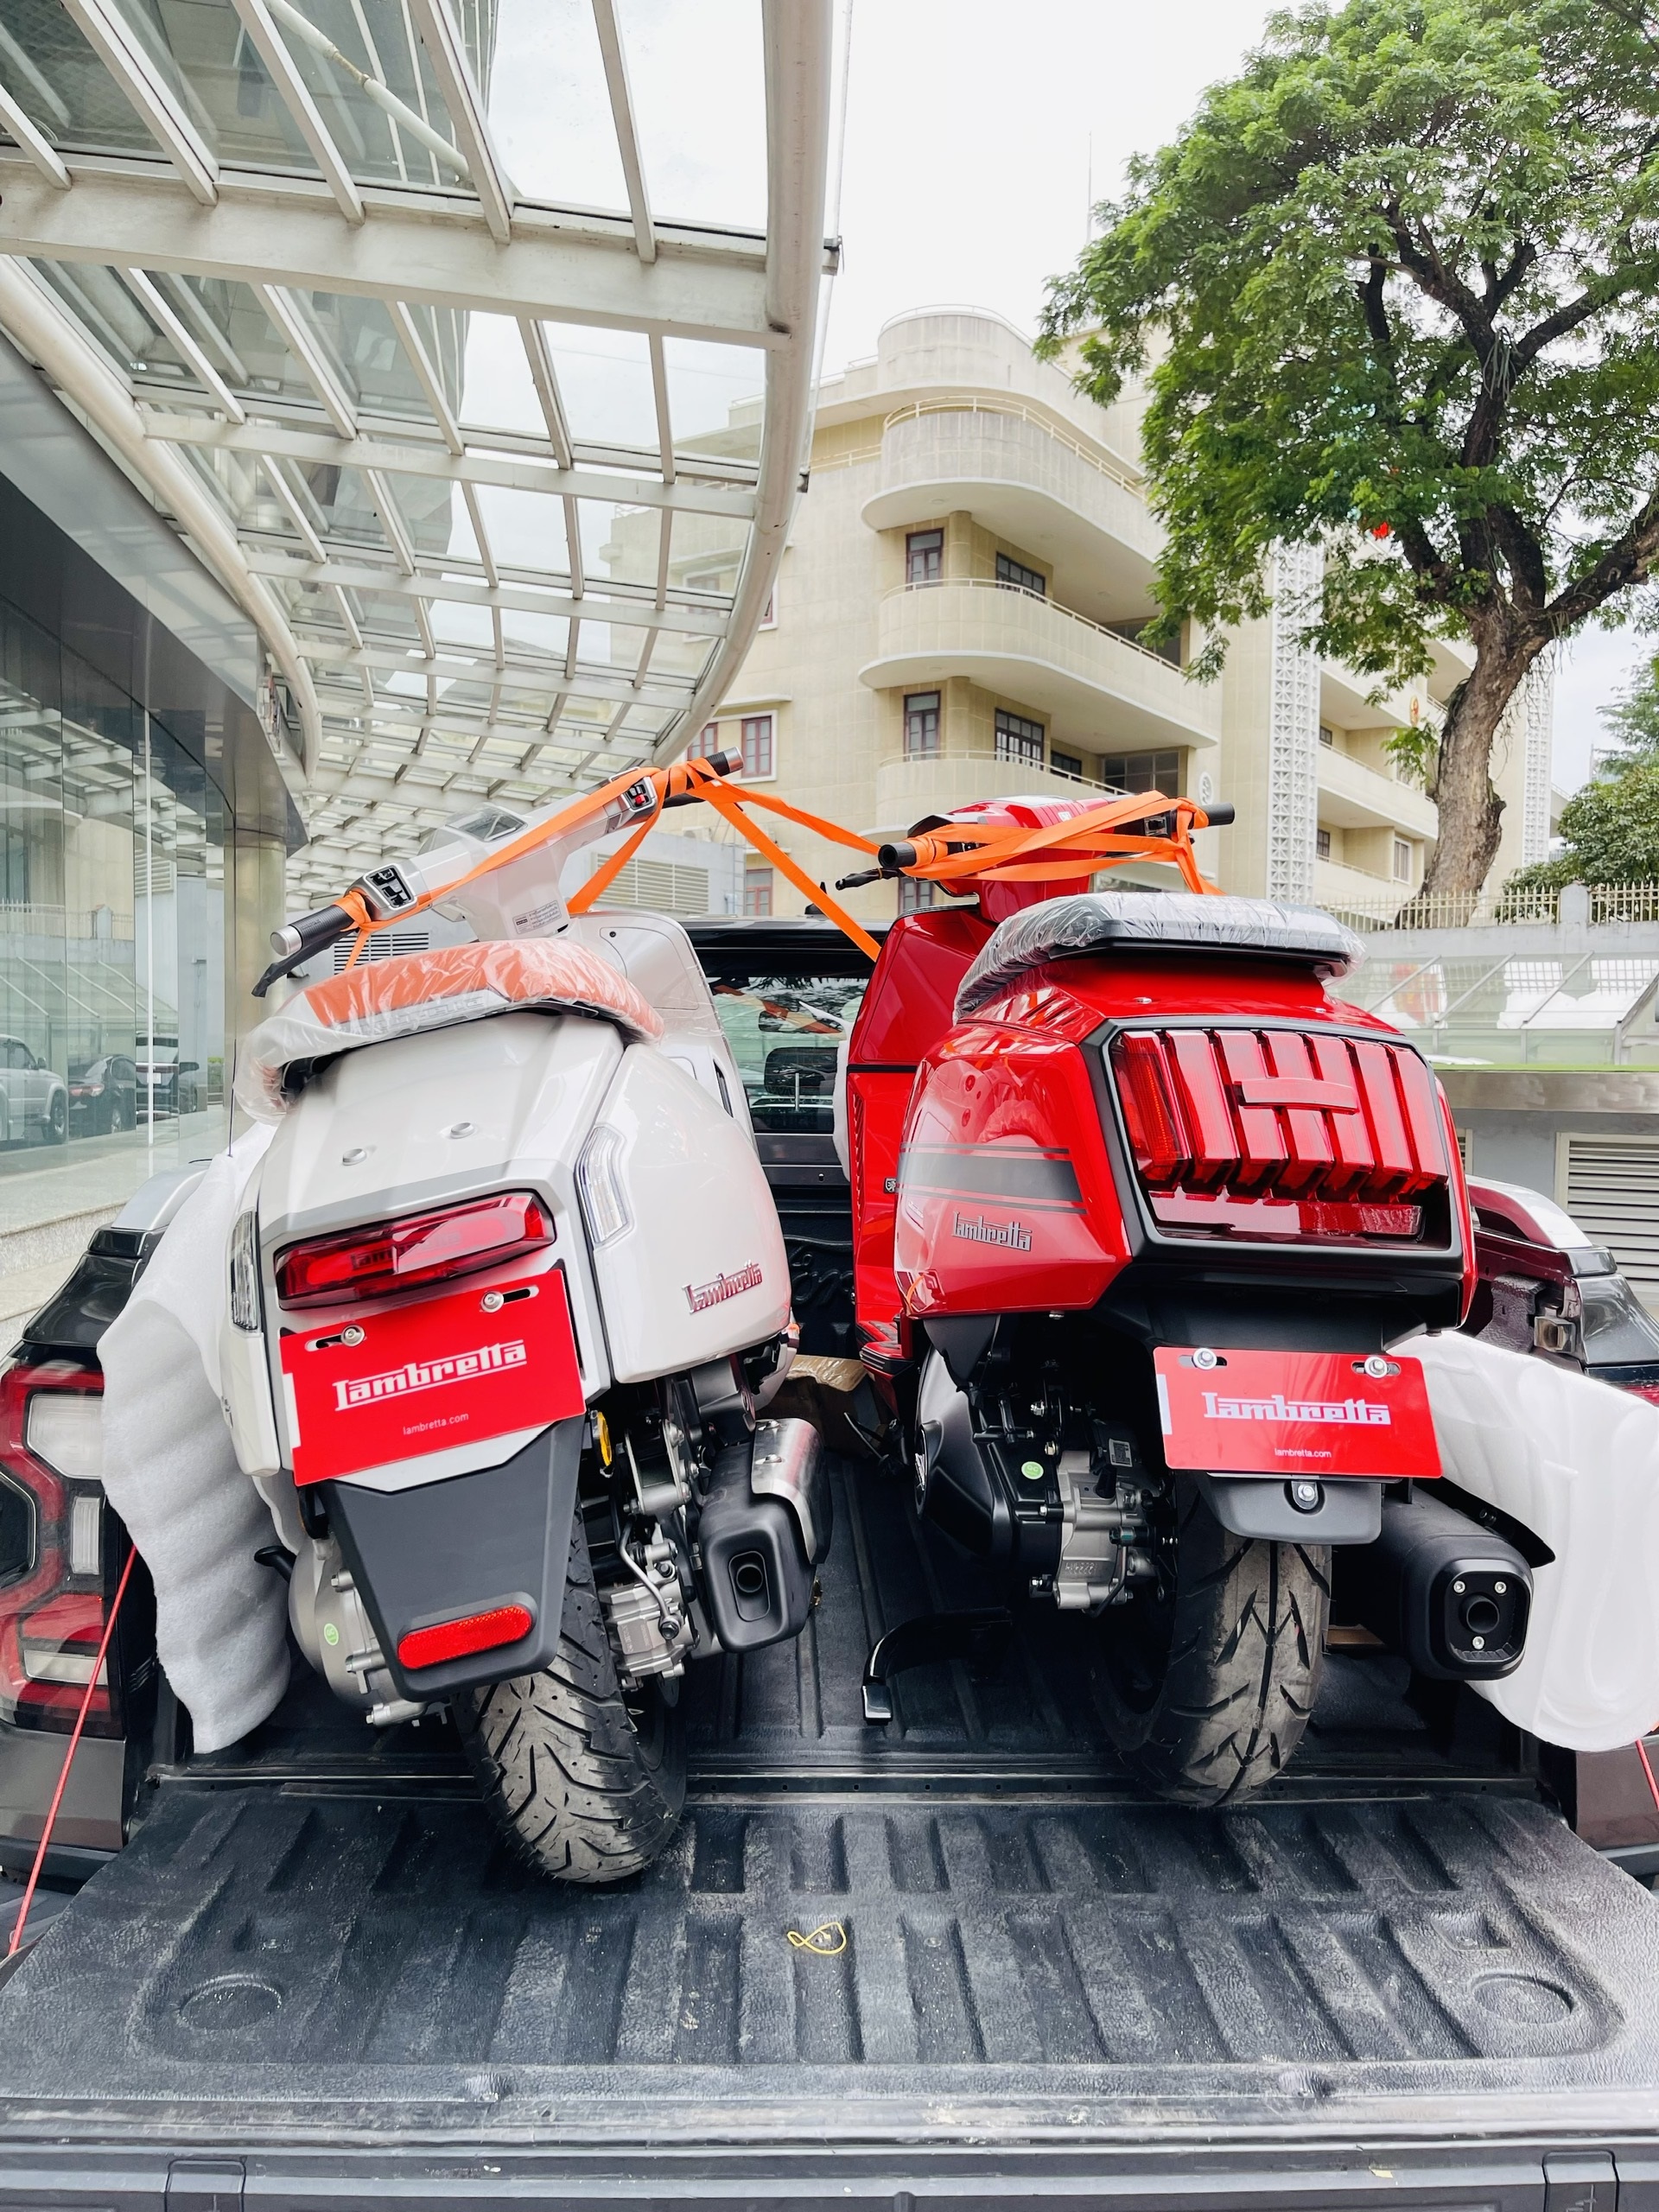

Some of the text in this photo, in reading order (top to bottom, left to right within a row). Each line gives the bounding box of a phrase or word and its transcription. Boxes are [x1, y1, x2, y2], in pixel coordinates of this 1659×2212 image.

[332, 1339, 527, 1411] Lambretta
[1201, 1392, 1392, 1425] Lambretta
[403, 1413, 469, 1435] lambretta.com
[1274, 1447, 1332, 1458] lambretta.com
